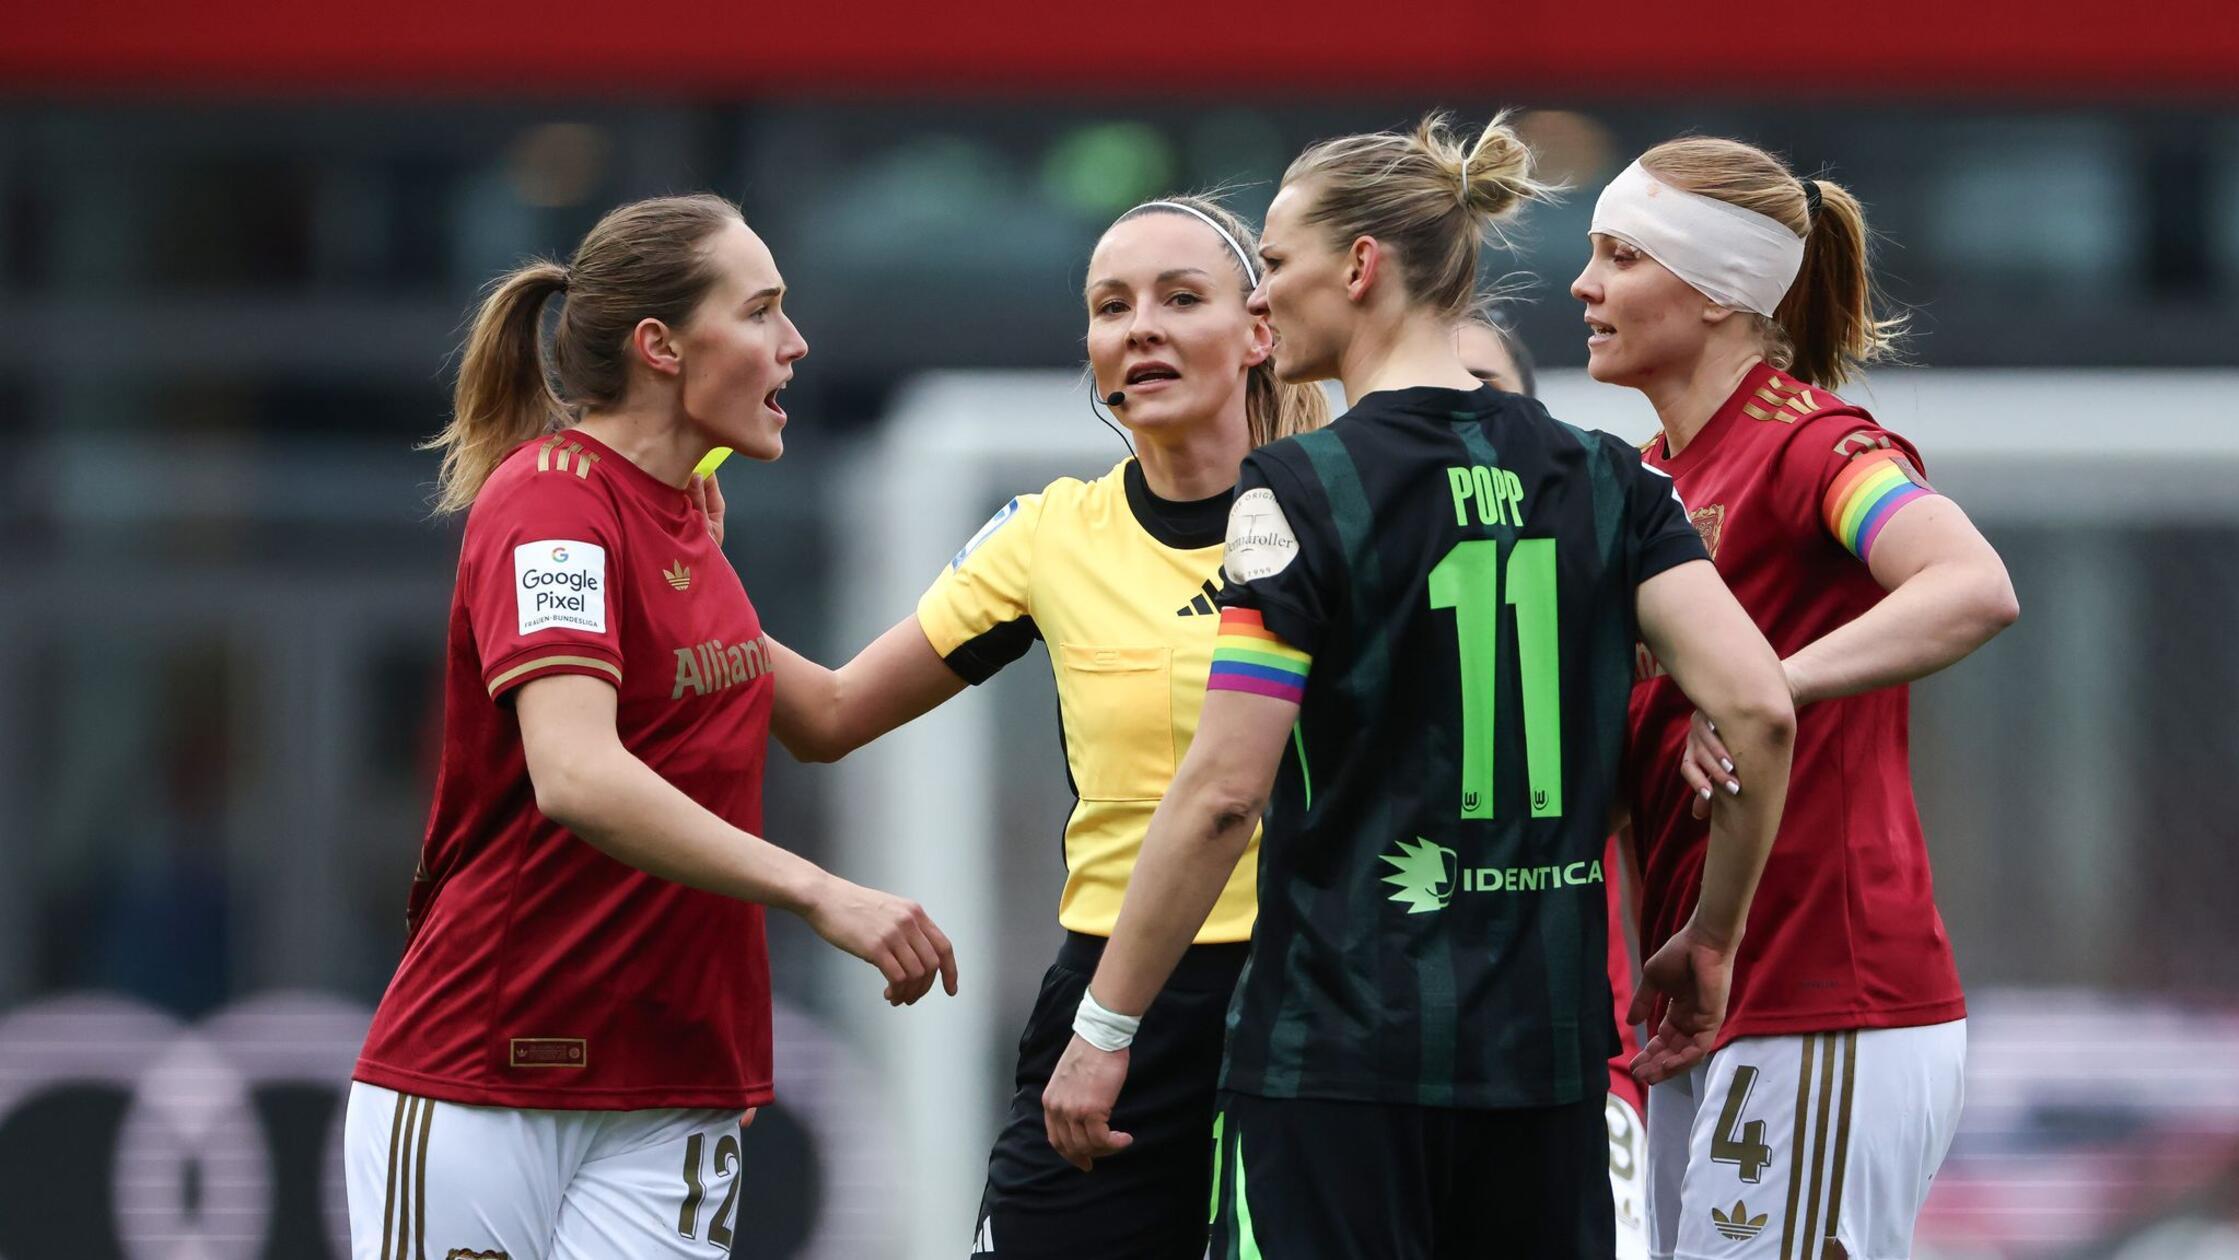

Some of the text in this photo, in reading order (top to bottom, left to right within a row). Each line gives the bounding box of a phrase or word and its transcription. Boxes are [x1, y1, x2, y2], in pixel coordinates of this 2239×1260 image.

[1447, 466, 1525, 527] POPP
[551, 547, 569, 563] G
[522, 568, 598, 592] Google
[536, 591, 585, 613] Pixel
[1428, 538, 1563, 820] 11
[1463, 859, 1604, 892] IDENTICA
[1710, 1065, 1773, 1184] 4
[678, 1132, 741, 1253] 12
